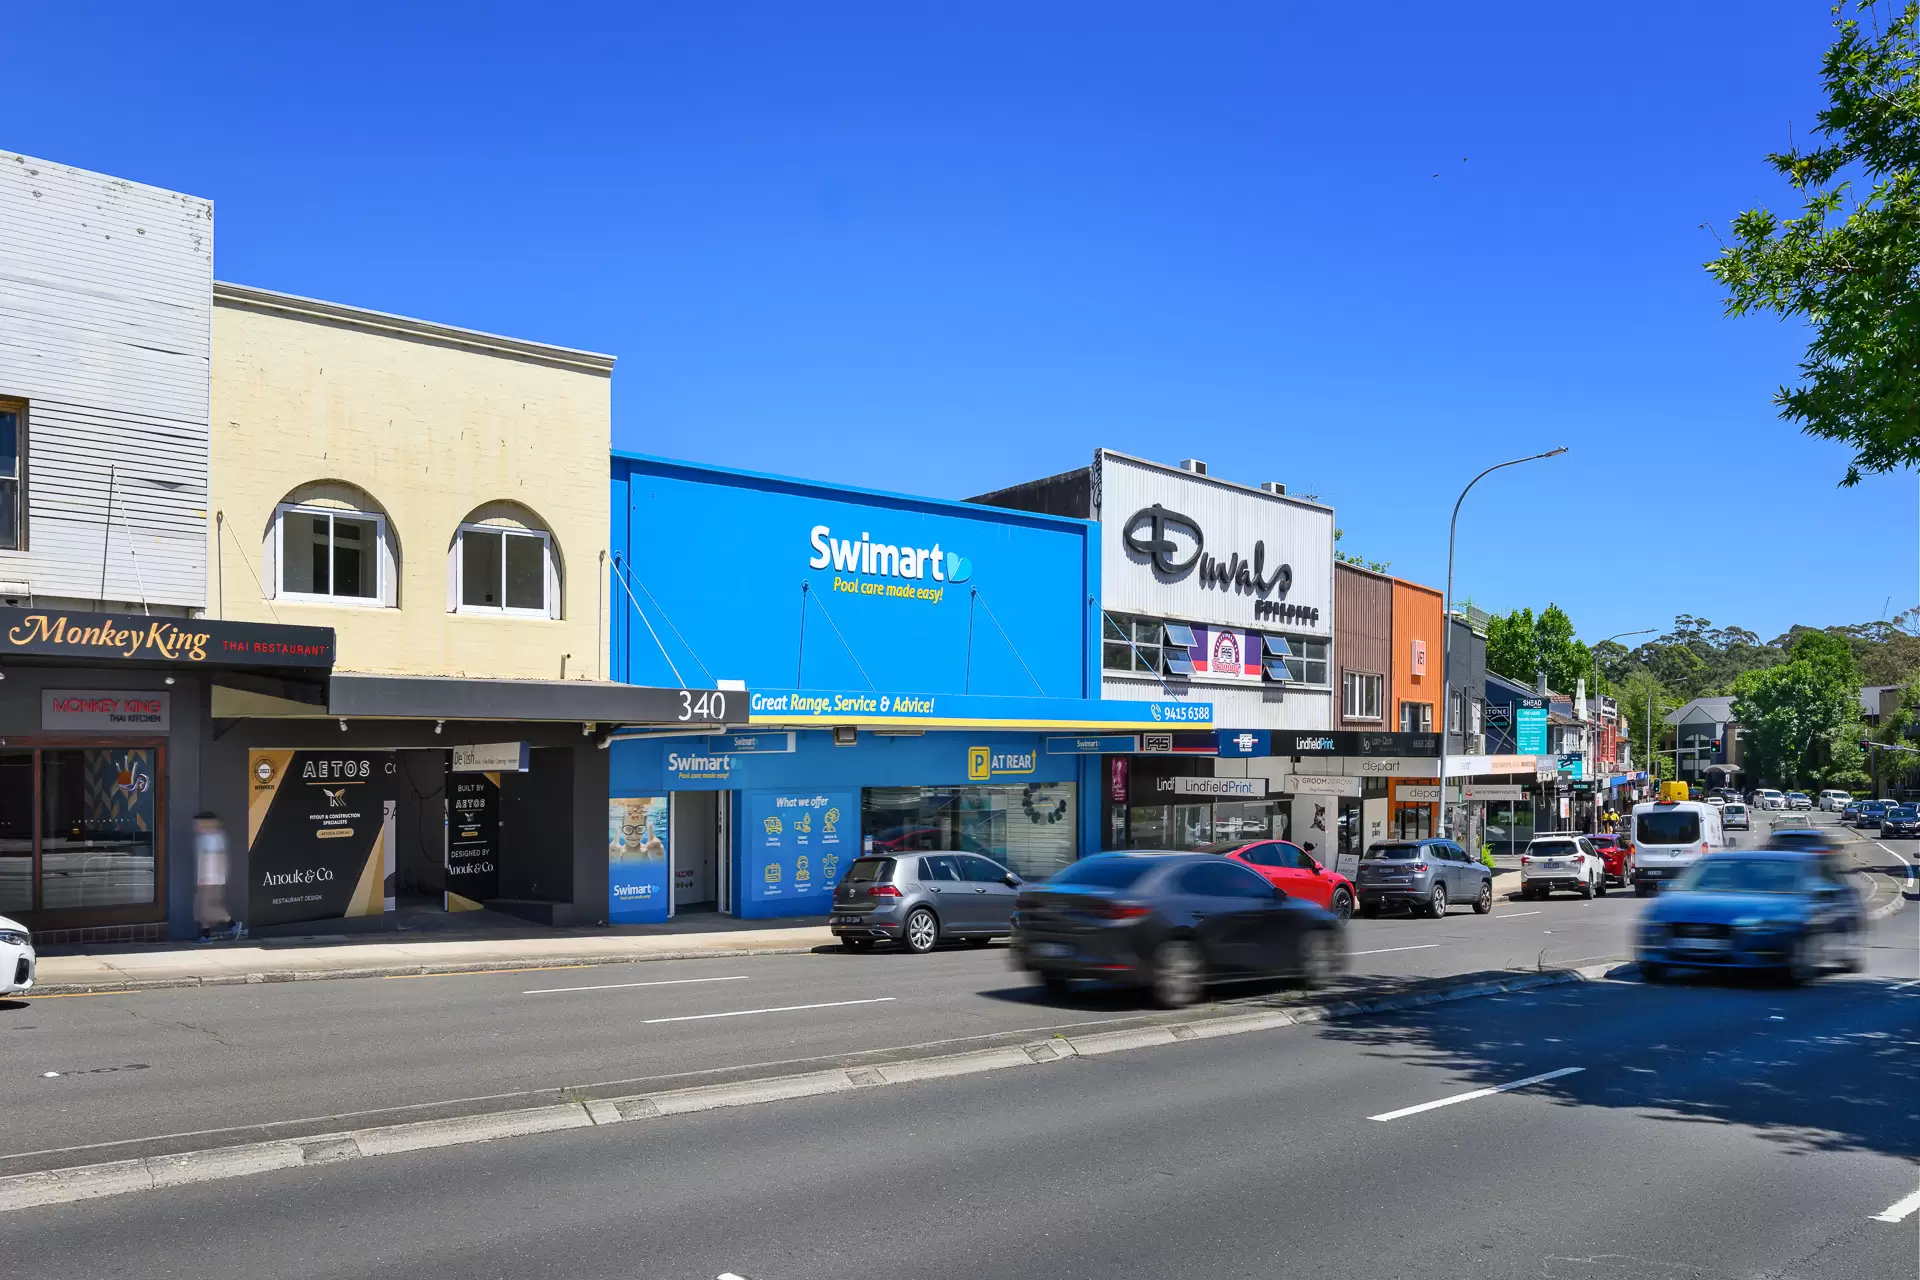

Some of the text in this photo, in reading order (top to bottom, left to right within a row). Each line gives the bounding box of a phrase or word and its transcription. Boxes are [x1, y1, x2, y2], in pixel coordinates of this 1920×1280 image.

[809, 525, 944, 582] Swimart
[1122, 503, 1293, 591] Duvals
[833, 577, 944, 604] Pool care made easy!
[222, 640, 326, 656] THAI RESTAURANT
[1417, 651, 1425, 665] VET
[53, 699, 161, 714] MONKEY KING
[678, 690, 726, 721] 340
[751, 693, 935, 715] Great Range, Service & Advice!
[1522, 699, 1542, 707] SHEAD
[109, 714, 161, 723] THAI KITCHEN
[1164, 707, 1209, 721] 9415 6388
[733, 737, 756, 747] Swimart
[1076, 740, 1099, 748] Swimart
[1146, 735, 1170, 752] F45
[668, 752, 730, 771] Swimart
[991, 754, 1032, 769] AT REAR
[1362, 760, 1400, 773] depart
[302, 760, 370, 778] AETOS
[457, 784, 475, 792] BUILT
[1409, 786, 1440, 799] depar
[455, 799, 486, 808] AETOS
[776, 796, 829, 809] What we offer
[451, 849, 481, 858] DESIGNED
[473, 863, 482, 873] &
[262, 867, 334, 886] Anouk & Co.
[613, 884, 652, 896] Swimart
[272, 894, 323, 904] RESTAURANT DESIGN
